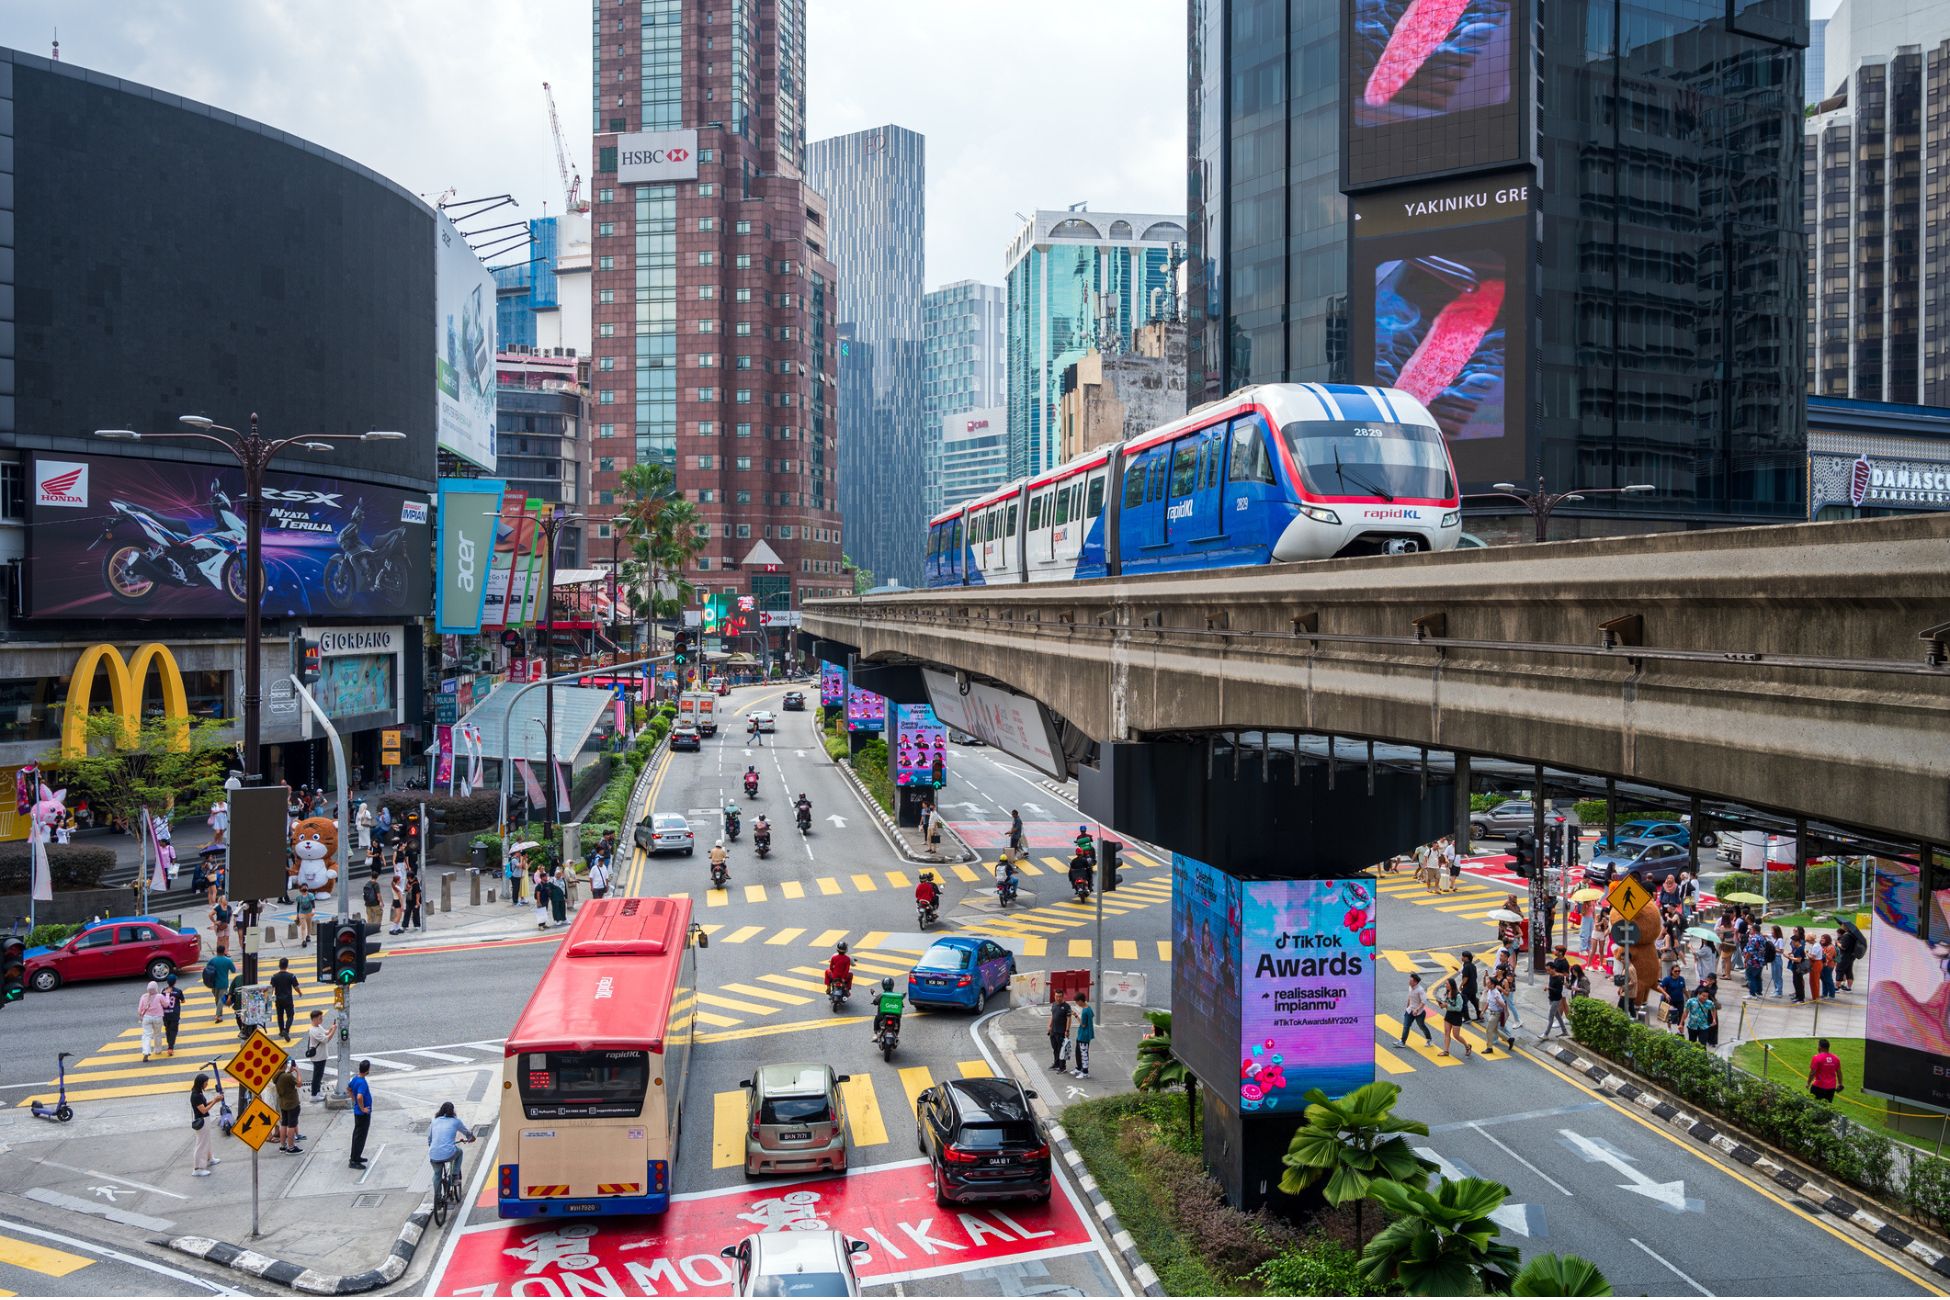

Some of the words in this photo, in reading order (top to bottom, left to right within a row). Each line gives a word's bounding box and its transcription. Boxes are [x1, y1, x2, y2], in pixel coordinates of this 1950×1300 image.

[622, 149, 664, 165] HSBC
[1404, 192, 1487, 217] YAKINIKU
[1495, 186, 1528, 204] GRE
[1353, 428, 1383, 437] 2829
[41, 494, 83, 503] HONDA
[1871, 489, 1943, 502] DAMASCUS
[1167, 499, 1194, 523] rapidKL
[1236, 497, 1249, 511] 2829
[269, 508, 310, 520] NYATA
[402, 508, 426, 522] IMPIAN
[1364, 509, 1421, 520] rapidKL
[278, 517, 333, 533] TERUJA
[458, 530, 475, 592] acer
[321, 631, 390, 652] GIORDANO
[1292, 934, 1342, 948] TikTok
[1255, 952, 1362, 978] Awards
[1274, 987, 1347, 1000] realisasikan
[1274, 1000, 1336, 1014] impianmu
[1273, 1017, 1359, 1026] #TikTokAwardsMY2024
[605, 1051, 641, 1060] rapidKL
